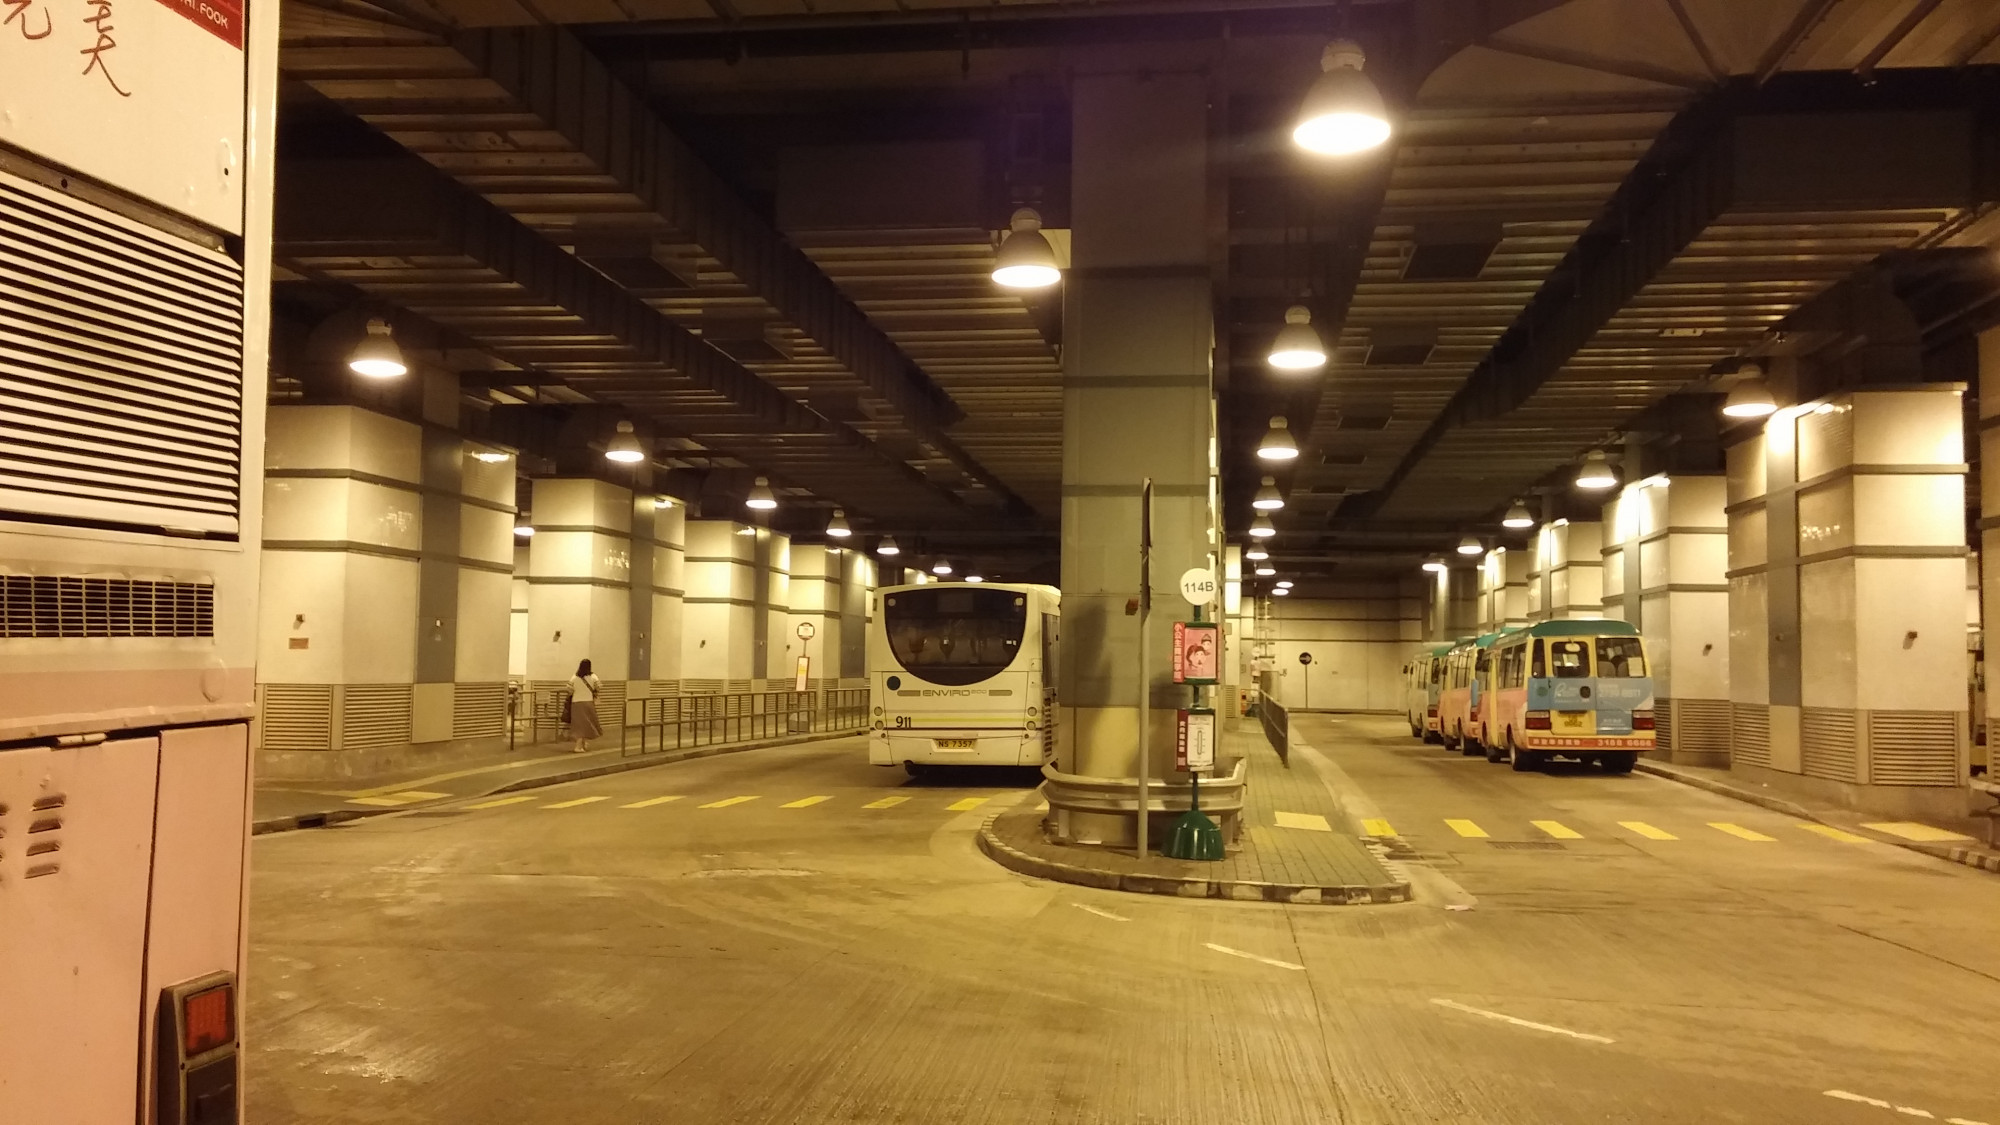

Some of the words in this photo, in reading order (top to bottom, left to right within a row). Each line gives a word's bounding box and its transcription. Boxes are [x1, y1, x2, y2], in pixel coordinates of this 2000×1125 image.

[199, 2, 229, 30] FOOK
[1184, 581, 1214, 593] 114B
[896, 716, 911, 728] 911
[952, 740, 973, 748] 7357
